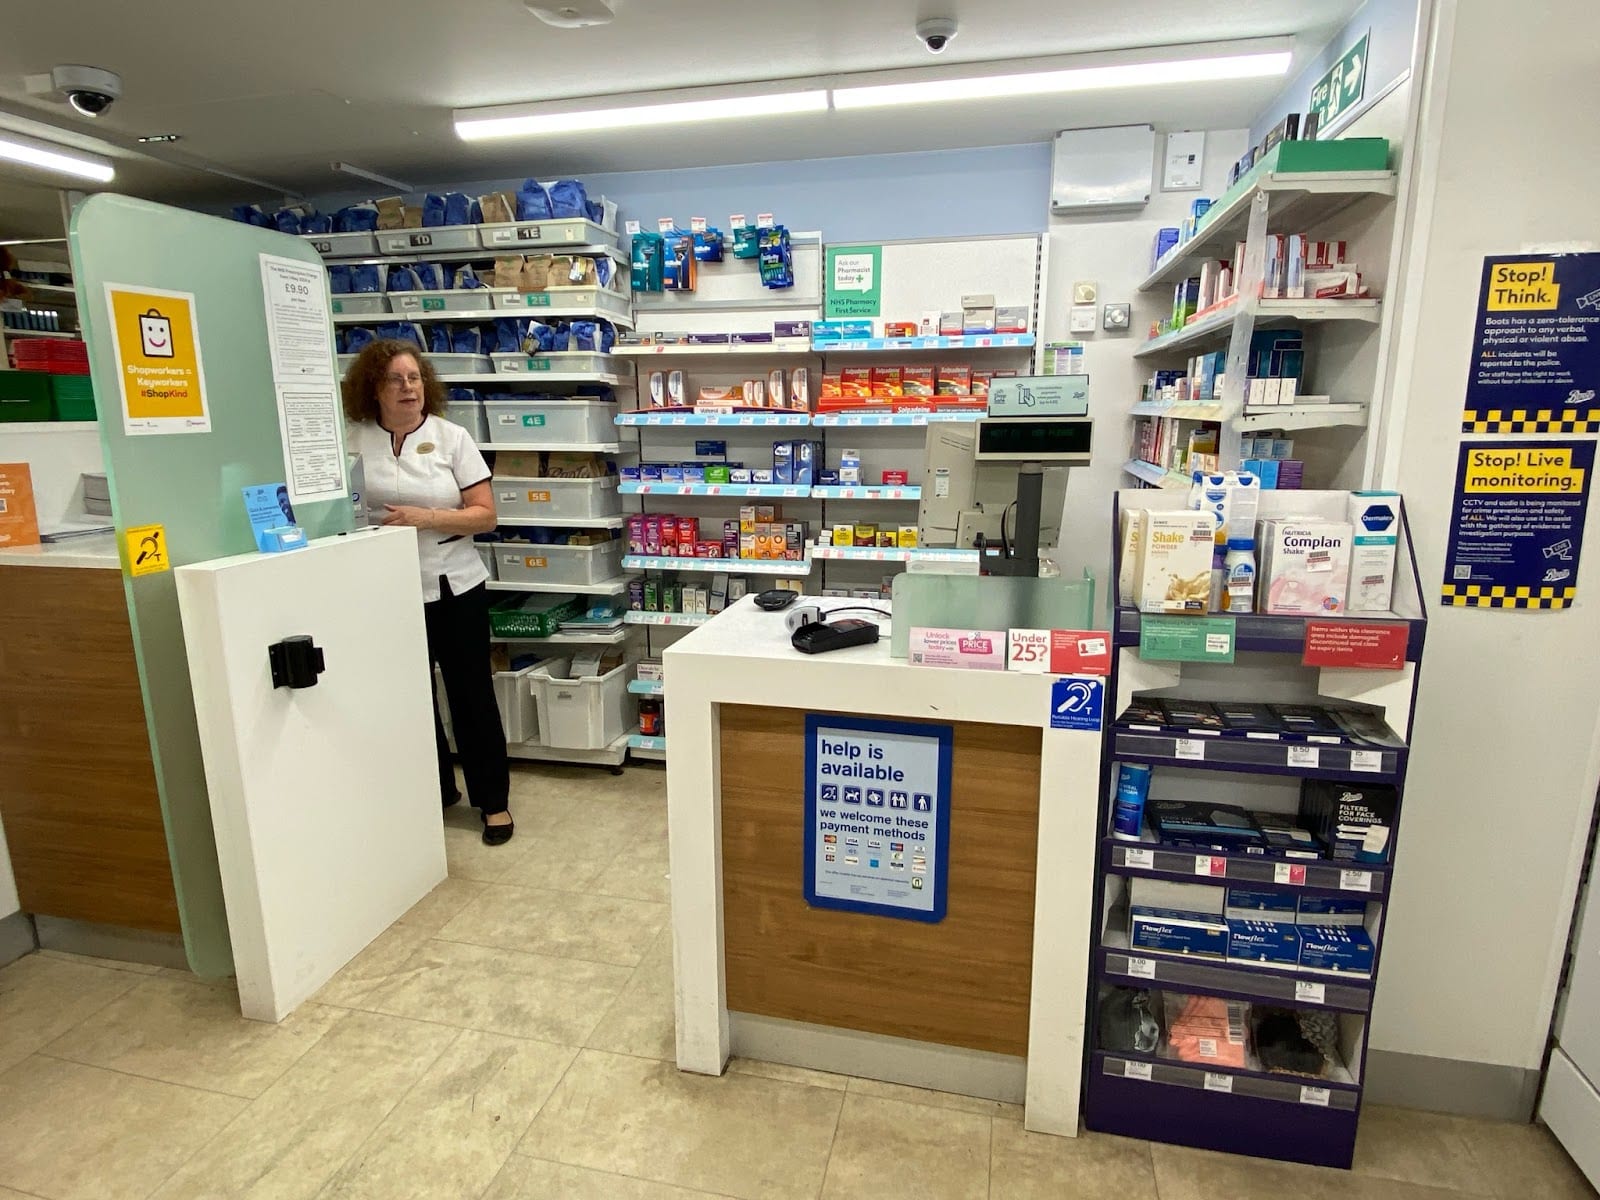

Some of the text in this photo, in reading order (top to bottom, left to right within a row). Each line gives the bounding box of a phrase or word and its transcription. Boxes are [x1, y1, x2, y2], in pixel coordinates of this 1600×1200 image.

[1312, 83, 1328, 108] Fire
[522, 229, 539, 238] 1E
[416, 235, 430, 245] 1D
[1497, 266, 1546, 286] Stop!
[285, 283, 309, 295] £9.90
[531, 296, 547, 305] 2E
[1495, 288, 1551, 304] Think.
[846, 298, 877, 306] Pharmacy
[1486, 317, 1509, 325] Boots
[1536, 315, 1599, 324] zero-tolerance
[1484, 326, 1526, 335] approach
[1538, 326, 1555, 334] any
[1556, 325, 1586, 333] verbal,
[1483, 336, 1517, 345] physical
[1560, 334, 1589, 342] abuse.
[127, 365, 184, 376] Shopworkers
[137, 378, 188, 388] Keyworkers
[141, 390, 187, 398] #ShopKind
[1564, 390, 1595, 404] Boots
[526, 417, 542, 425] 4E
[1474, 453, 1564, 470] Stop! Live
[1471, 473, 1576, 491] monitoring.
[1153, 531, 1184, 543] Shake
[1459, 530, 1502, 538] investigation
[1284, 536, 1341, 549] Complan
[1542, 568, 1570, 581] Boots
[1012, 632, 1047, 643] Under
[928, 644, 945, 652] today
[963, 640, 989, 649] PRICE
[1012, 643, 1048, 662] 25?
[822, 739, 884, 760] help is
[821, 762, 905, 782] available
[1340, 804, 1368, 812] FILTERS
[820, 809, 929, 829] we welcome these
[820, 821, 926, 841] payment methods
[1142, 925, 1173, 934] Flowflex
[1234, 933, 1265, 943] Flowflex
[1306, 943, 1338, 951] Flowflex
